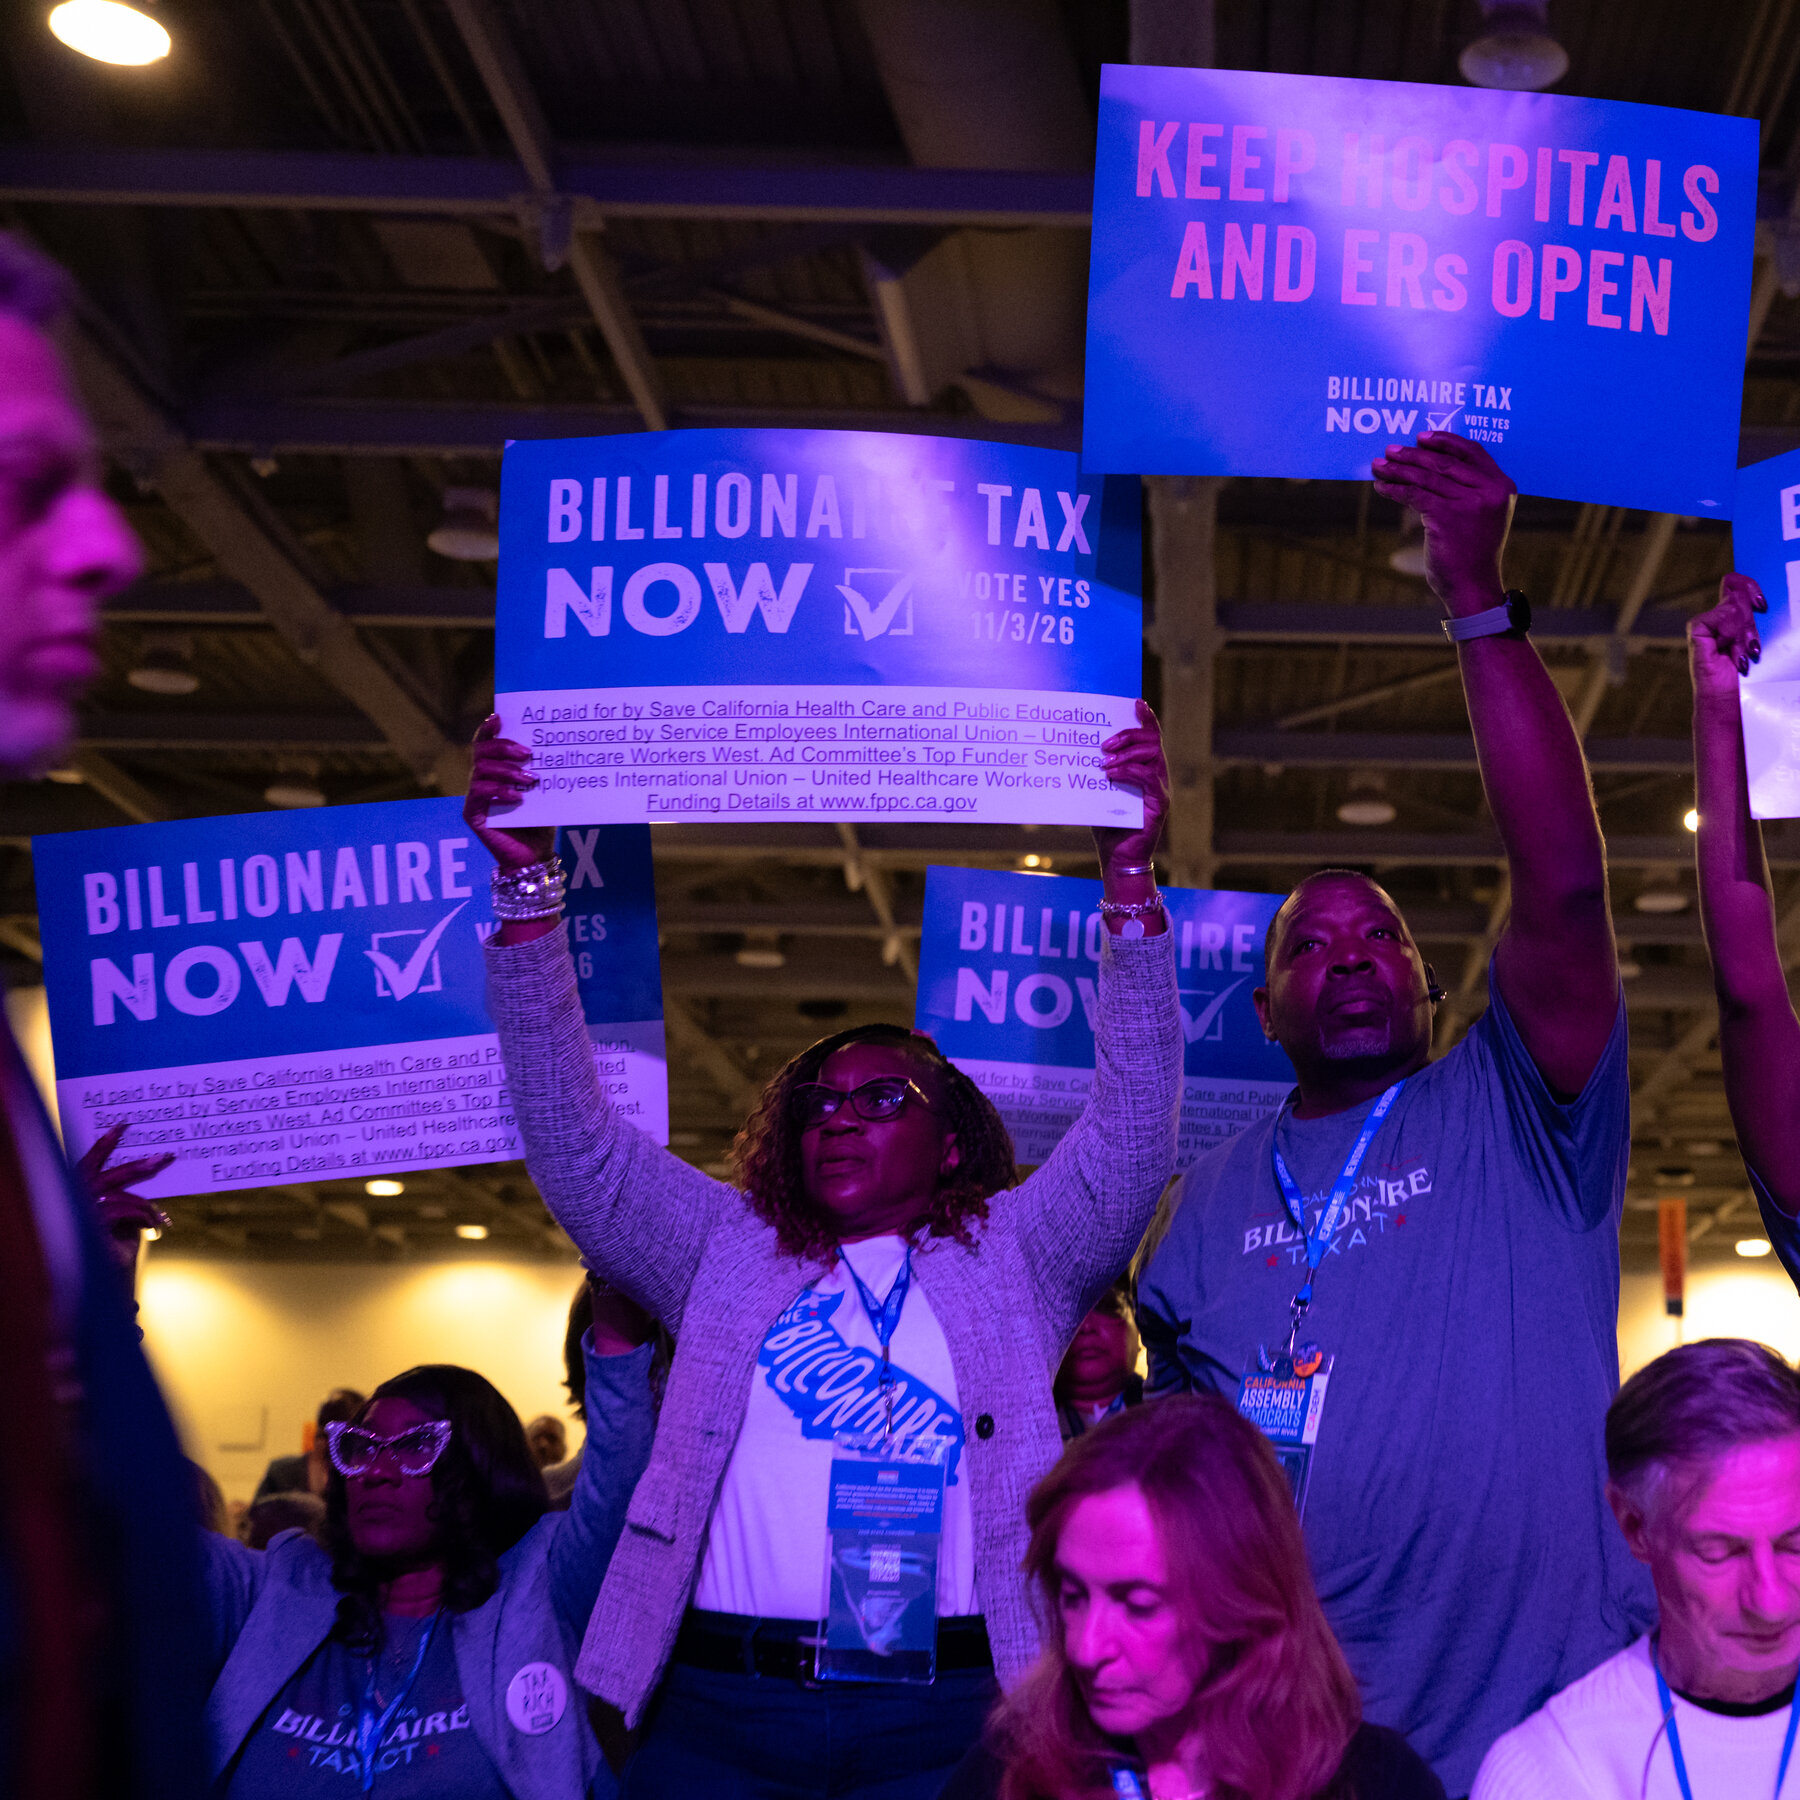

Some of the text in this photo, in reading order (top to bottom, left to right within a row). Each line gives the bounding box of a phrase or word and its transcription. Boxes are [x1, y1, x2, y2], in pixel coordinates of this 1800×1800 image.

[1136, 120, 1719, 243] KEEP HOSPITALS
[1170, 221, 1672, 336] AND ERs OPEN
[1327, 376, 1512, 411] BILLIONAIRE TAX
[1326, 406, 1418, 435] NOW
[1464, 414, 1510, 430] VOTE YES
[1469, 428, 1504, 443] 11/3/26
[547, 471, 1092, 555] BILLIONAIE TAX
[544, 562, 814, 638] NOW
[960, 571, 1091, 608] VOTE YES
[971, 610, 1075, 646] 11/3/26
[521, 700, 1111, 725] Ad paid for by Save California Health Care and Public Education,
[532, 726, 626, 746] Sponsored
[633, 725, 654, 743] by
[660, 724, 728, 740] Service
[735, 724, 837, 742] Employees
[844, 724, 958, 741] International
[965, 727, 1018, 741] Union
[1042, 727, 1100, 745] United
[531, 749, 624, 768] Healthcare
[631, 748, 706, 763] Workers
[712, 747, 764, 762] West.
[770, 747, 794, 762] Ad
[923, 747, 955, 767] Top
[963, 748, 1028, 765] Funder
[1034, 750, 1101, 768] Service
[615, 771, 727, 788] International
[734, 770, 787, 786] Union
[812, 770, 871, 786] United
[878, 770, 978, 786] Healthcare
[985, 771, 1061, 788] Workers
[647, 793, 977, 813] Funding Details at www.fppc.ca.gov
[84, 838, 472, 935] BILLIONAIRE
[959, 901, 1255, 973] BILLIOIRE
[90, 933, 344, 1027] NOW
[83, 1091, 104, 1105] Ad
[108, 1086, 144, 1104] paid
[149, 1082, 173, 1098] for
[177, 1080, 198, 1096] by
[202, 1076, 247, 1093] Save
[252, 1065, 334, 1087] California
[339, 1060, 396, 1077] Health
[401, 1056, 442, 1072] Care
[449, 1051, 479, 1066] and
[594, 1058, 625, 1072] ited
[94, 1104, 184, 1127] Sponsored
[190, 1101, 210, 1118] by
[215, 1094, 280, 1114] Service
[285, 1083, 381, 1106] Employees
[386, 1070, 492, 1095] International
[190, 1119, 262, 1138] Workers
[320, 1108, 344, 1124] Ad
[462, 1093, 493, 1110] Top
[611, 1100, 645, 1116] est.
[176, 1137, 284, 1161] International
[290, 1132, 340, 1149] Union
[361, 1123, 416, 1142] United
[423, 1113, 516, 1135] Healthcare
[212, 1135, 517, 1180] Funding Details at www.fppc.ca.gov
[1240, 1389, 1306, 1410] ASSEMBLY
[375, 1742, 420, 1774] CT
